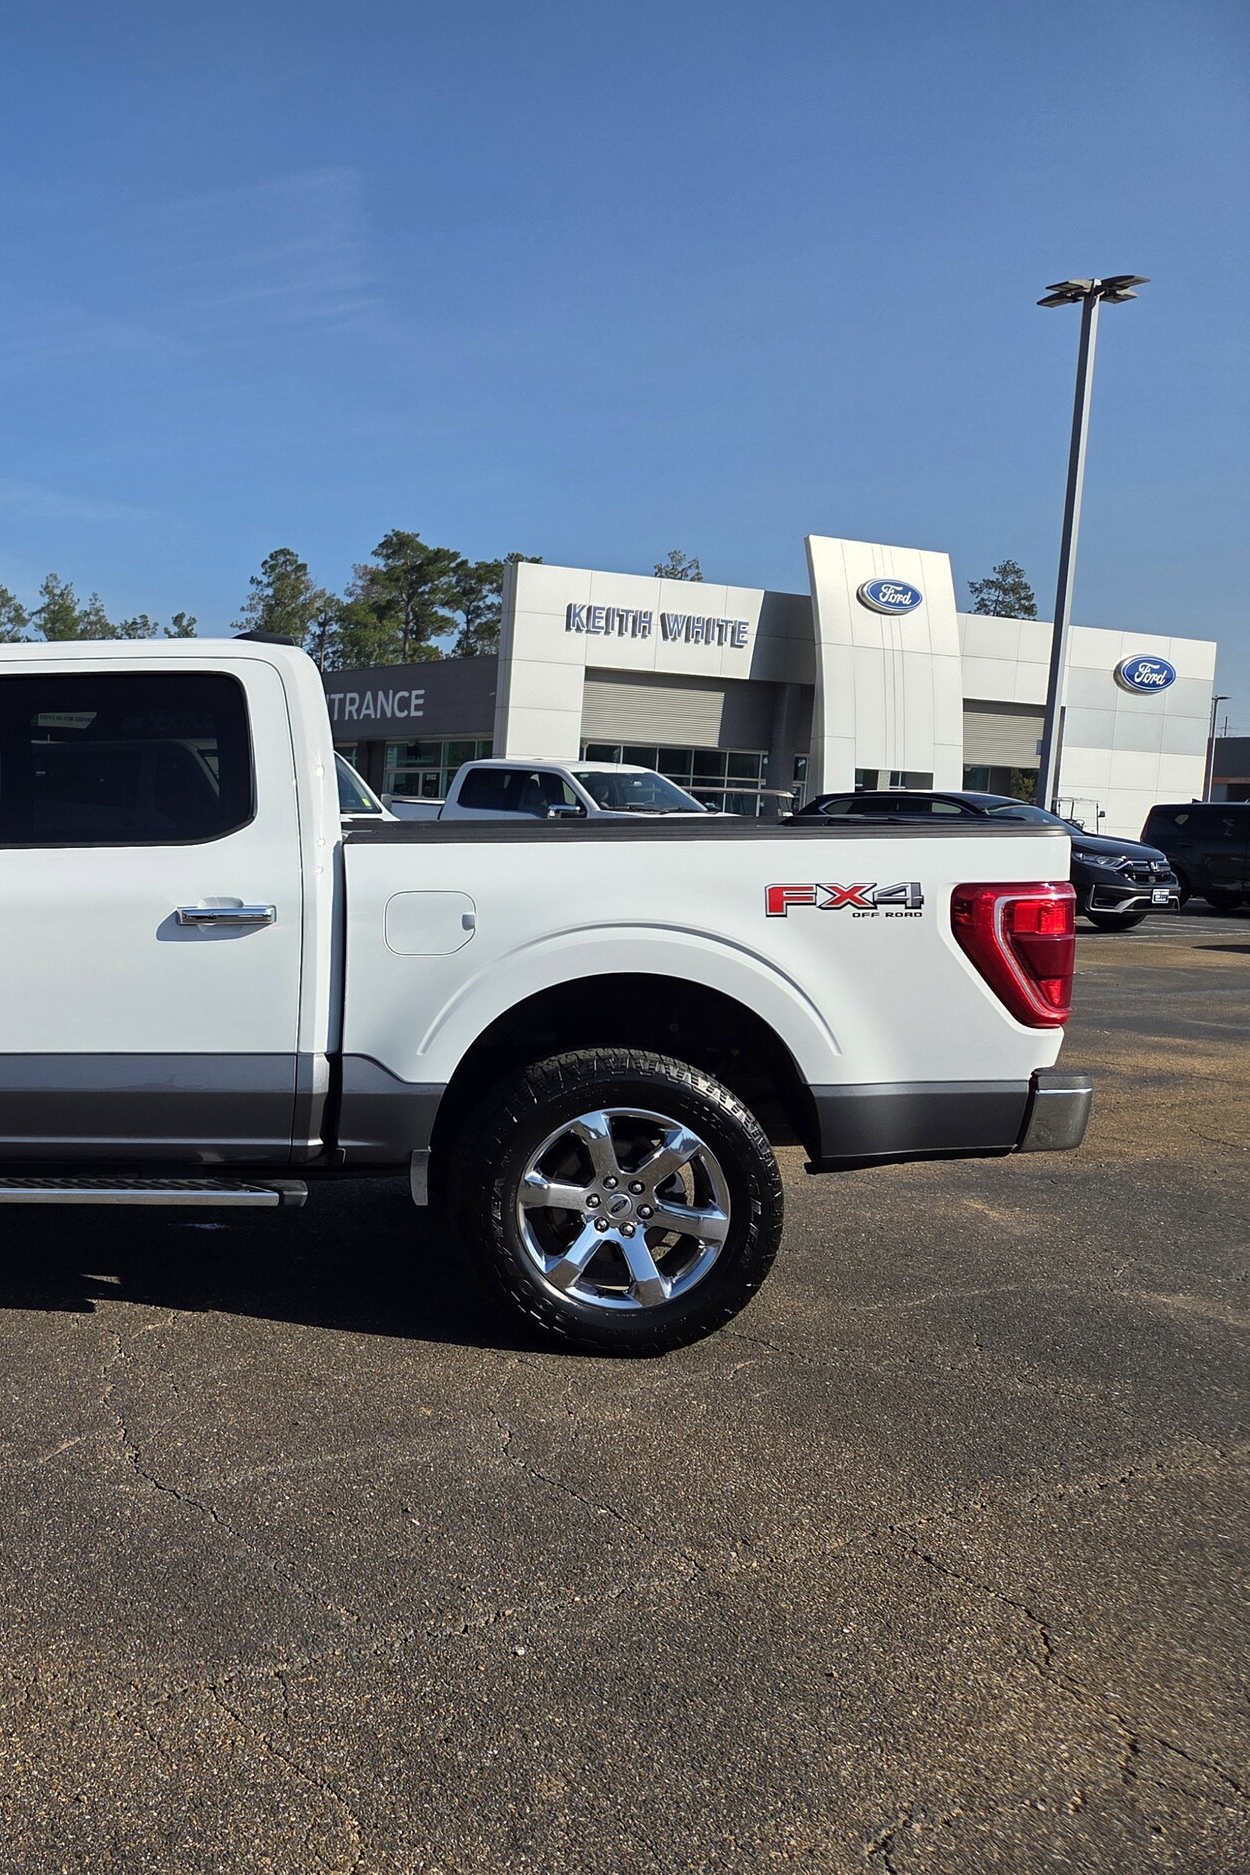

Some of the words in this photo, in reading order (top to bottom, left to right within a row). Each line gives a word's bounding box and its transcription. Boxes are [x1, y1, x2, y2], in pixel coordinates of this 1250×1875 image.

[879, 584, 912, 605] Ford
[566, 603, 652, 639] KEITH
[660, 613, 749, 648] WHITE
[1134, 662, 1168, 685] Ford
[326, 689, 426, 721] TRANCE
[765, 882, 924, 917] FX4
